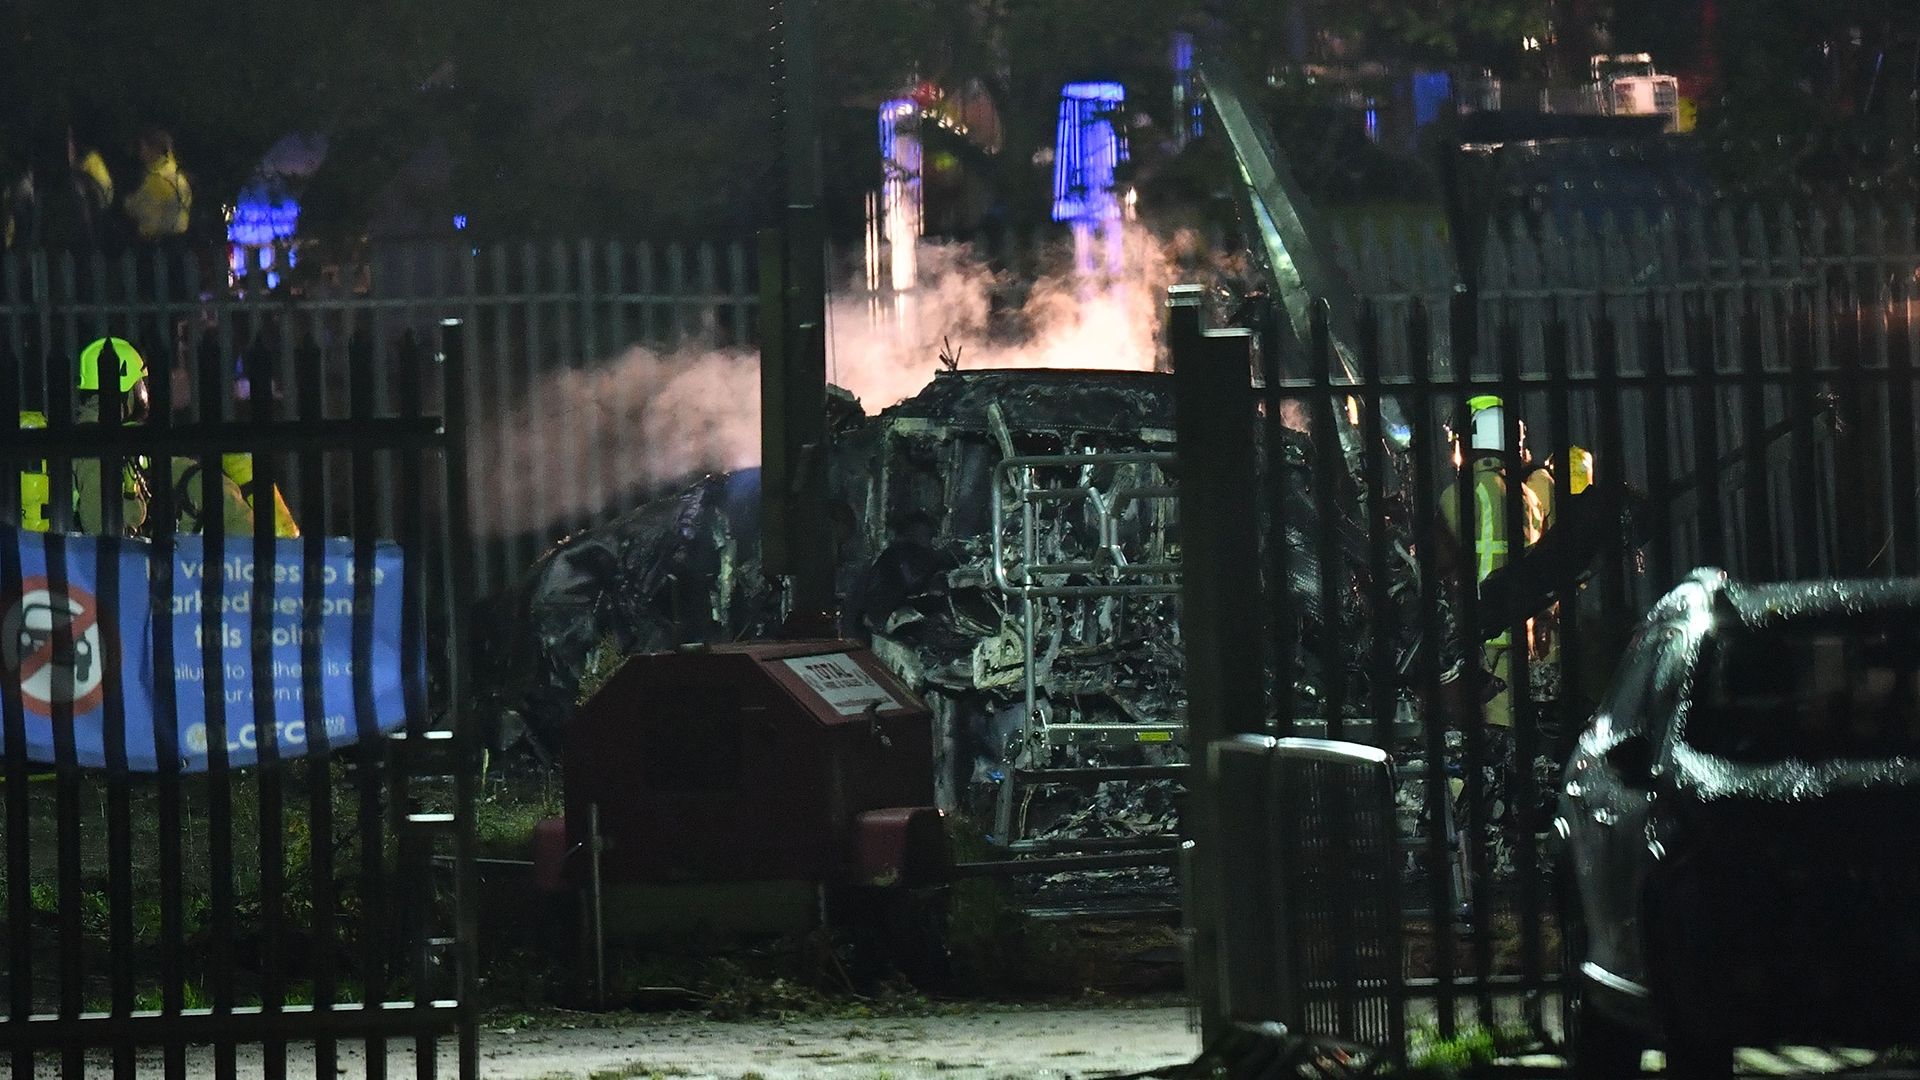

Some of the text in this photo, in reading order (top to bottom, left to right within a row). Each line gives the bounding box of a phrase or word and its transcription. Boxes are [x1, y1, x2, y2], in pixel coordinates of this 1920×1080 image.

[181, 557, 301, 584] vhices
[152, 590, 250, 617] arkd
[194, 621, 242, 649] tis
[805, 661, 853, 680] TOTAL
